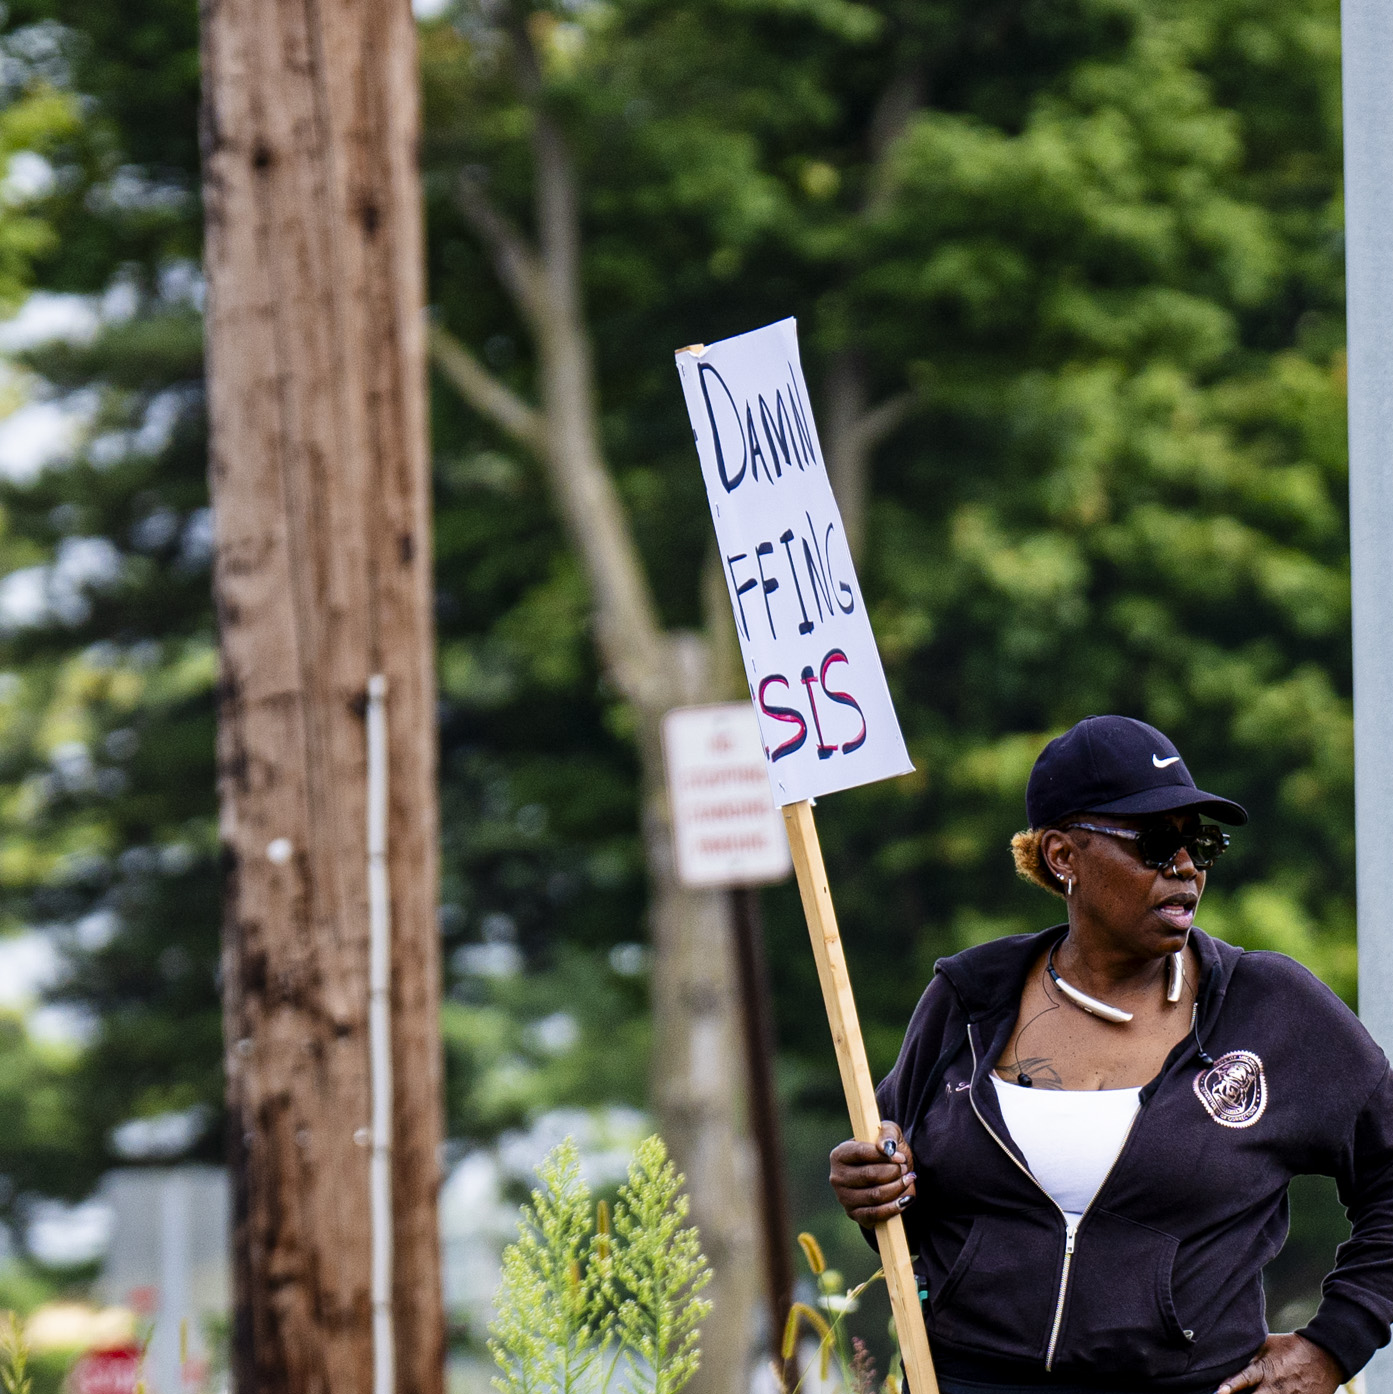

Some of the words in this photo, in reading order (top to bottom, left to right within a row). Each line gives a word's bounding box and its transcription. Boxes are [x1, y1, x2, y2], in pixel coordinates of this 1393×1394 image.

[698, 361, 817, 493] DAMN
[727, 510, 854, 642] FFING
[751, 648, 867, 763] SIS
